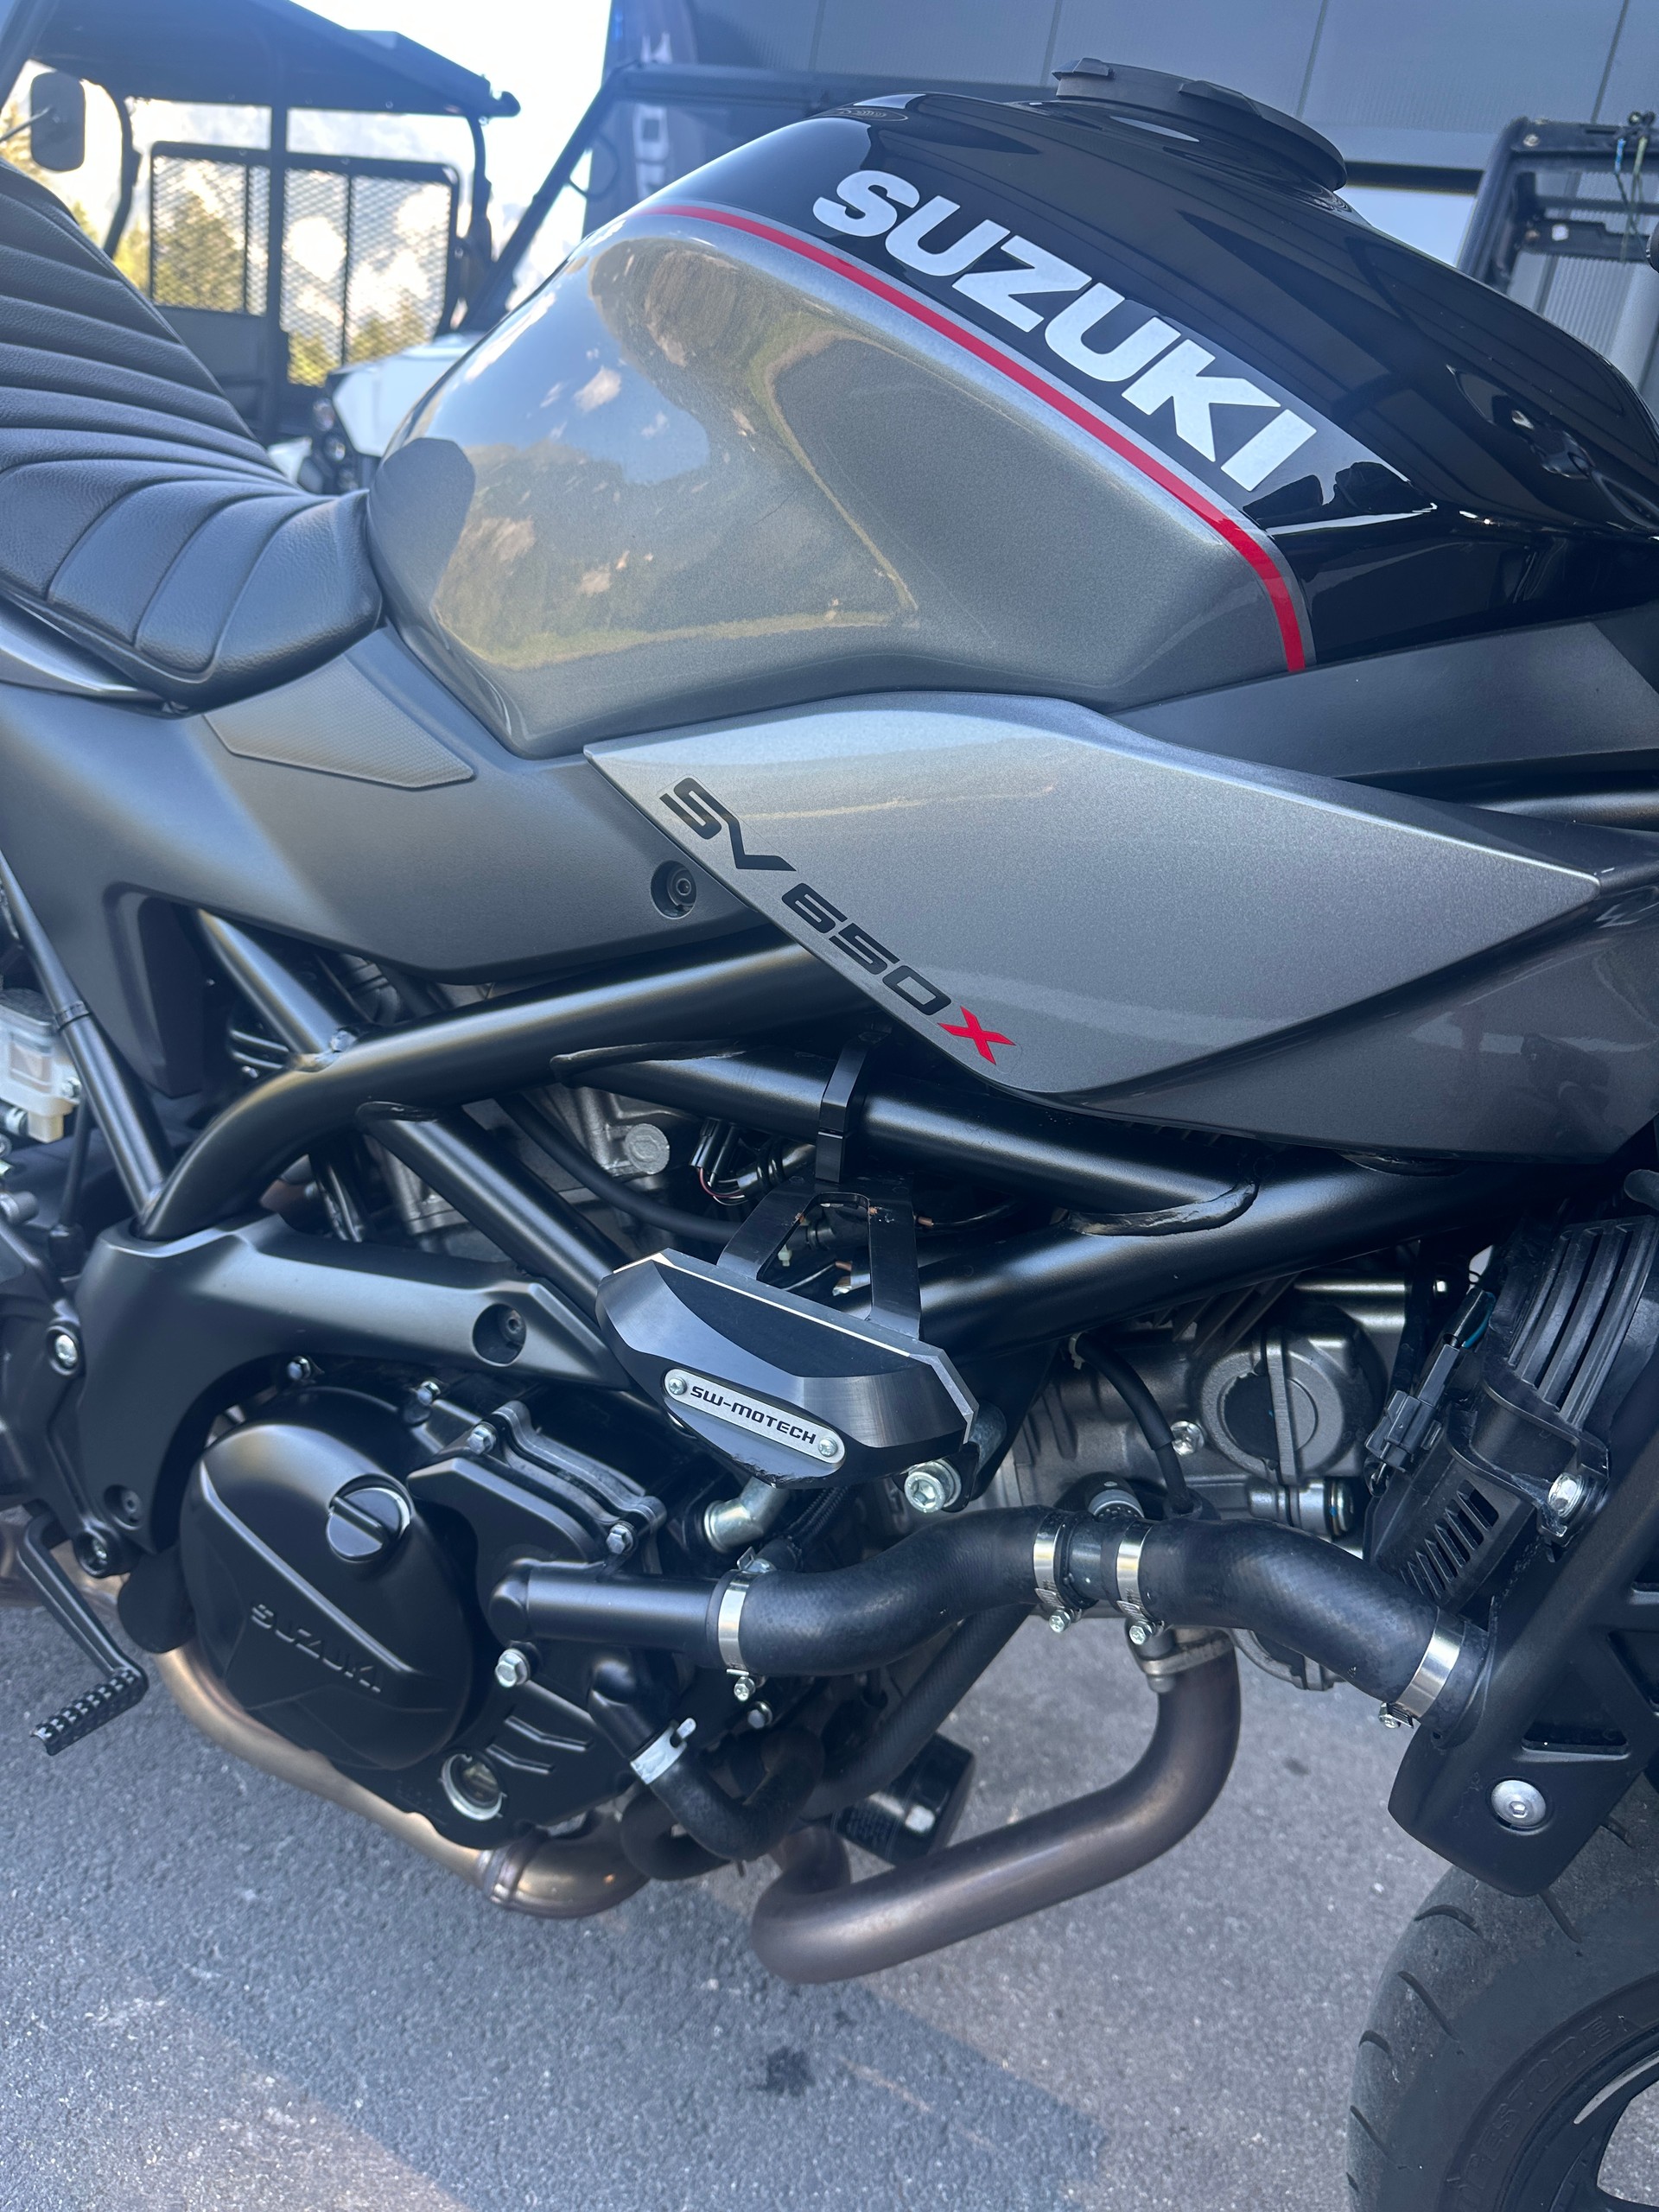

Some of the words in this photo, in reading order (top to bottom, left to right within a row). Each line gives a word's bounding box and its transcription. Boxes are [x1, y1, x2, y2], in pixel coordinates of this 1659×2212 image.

[813, 170, 1317, 493] SUZUKI
[690, 1385, 817, 1445] SW-MOTECH
[250, 1603, 384, 1694] SUZUKI
